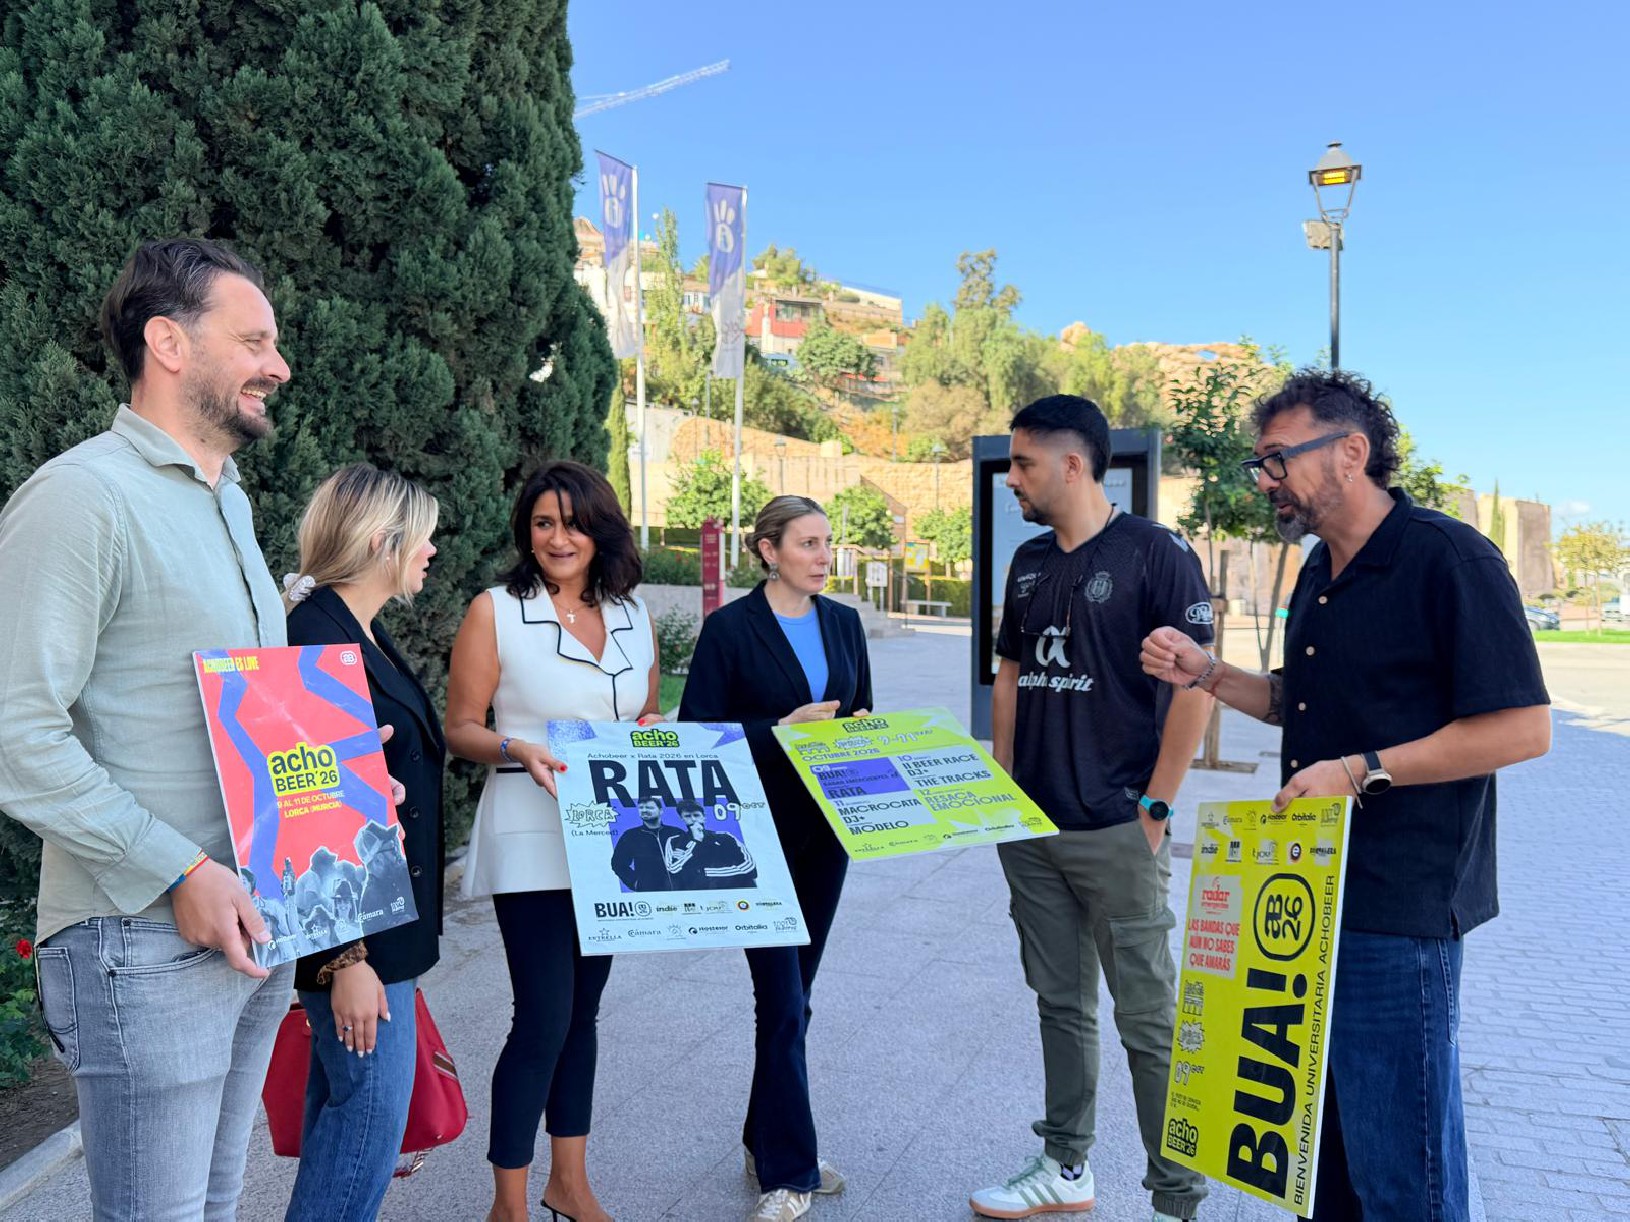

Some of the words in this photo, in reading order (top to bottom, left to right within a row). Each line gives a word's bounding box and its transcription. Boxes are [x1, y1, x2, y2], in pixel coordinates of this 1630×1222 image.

[1018, 671, 1048, 690] alph
[1049, 673, 1094, 692] spirit
[632, 729, 678, 740] acho
[271, 746, 333, 775] acho
[802, 751, 851, 761] OCTUBRE
[912, 758, 942, 769] BEER
[943, 754, 979, 765] RACE
[588, 760, 741, 808] RATA
[915, 778, 940, 788] THE
[941, 770, 992, 785] TRACKS
[828, 786, 867, 799] RATA
[924, 791, 976, 804] RESACA
[284, 799, 293, 807] AL
[838, 798, 922, 816] MACROCATA
[930, 793, 1017, 812] EMOCIONAL
[284, 807, 310, 818] LORCA
[572, 808, 615, 822] LORCA
[713, 802, 741, 821] 09
[849, 820, 909, 836] MODELO
[1202, 884, 1230, 902] radar
[594, 902, 635, 918] BUA!
[1200, 919, 1224, 935] BANDAS
[1225, 922, 1240, 937] QUE
[1215, 939, 1236, 954] SABES
[1190, 953, 1205, 967] QUE
[1294, 1102, 1313, 1205] BIENVENIDA
[1306, 970, 1327, 1096] UNIVERSITARIA
[1319, 875, 1335, 964] ACHOBEER
[1226, 968, 1308, 1200] BUA!
[1169, 1119, 1198, 1144] acho
